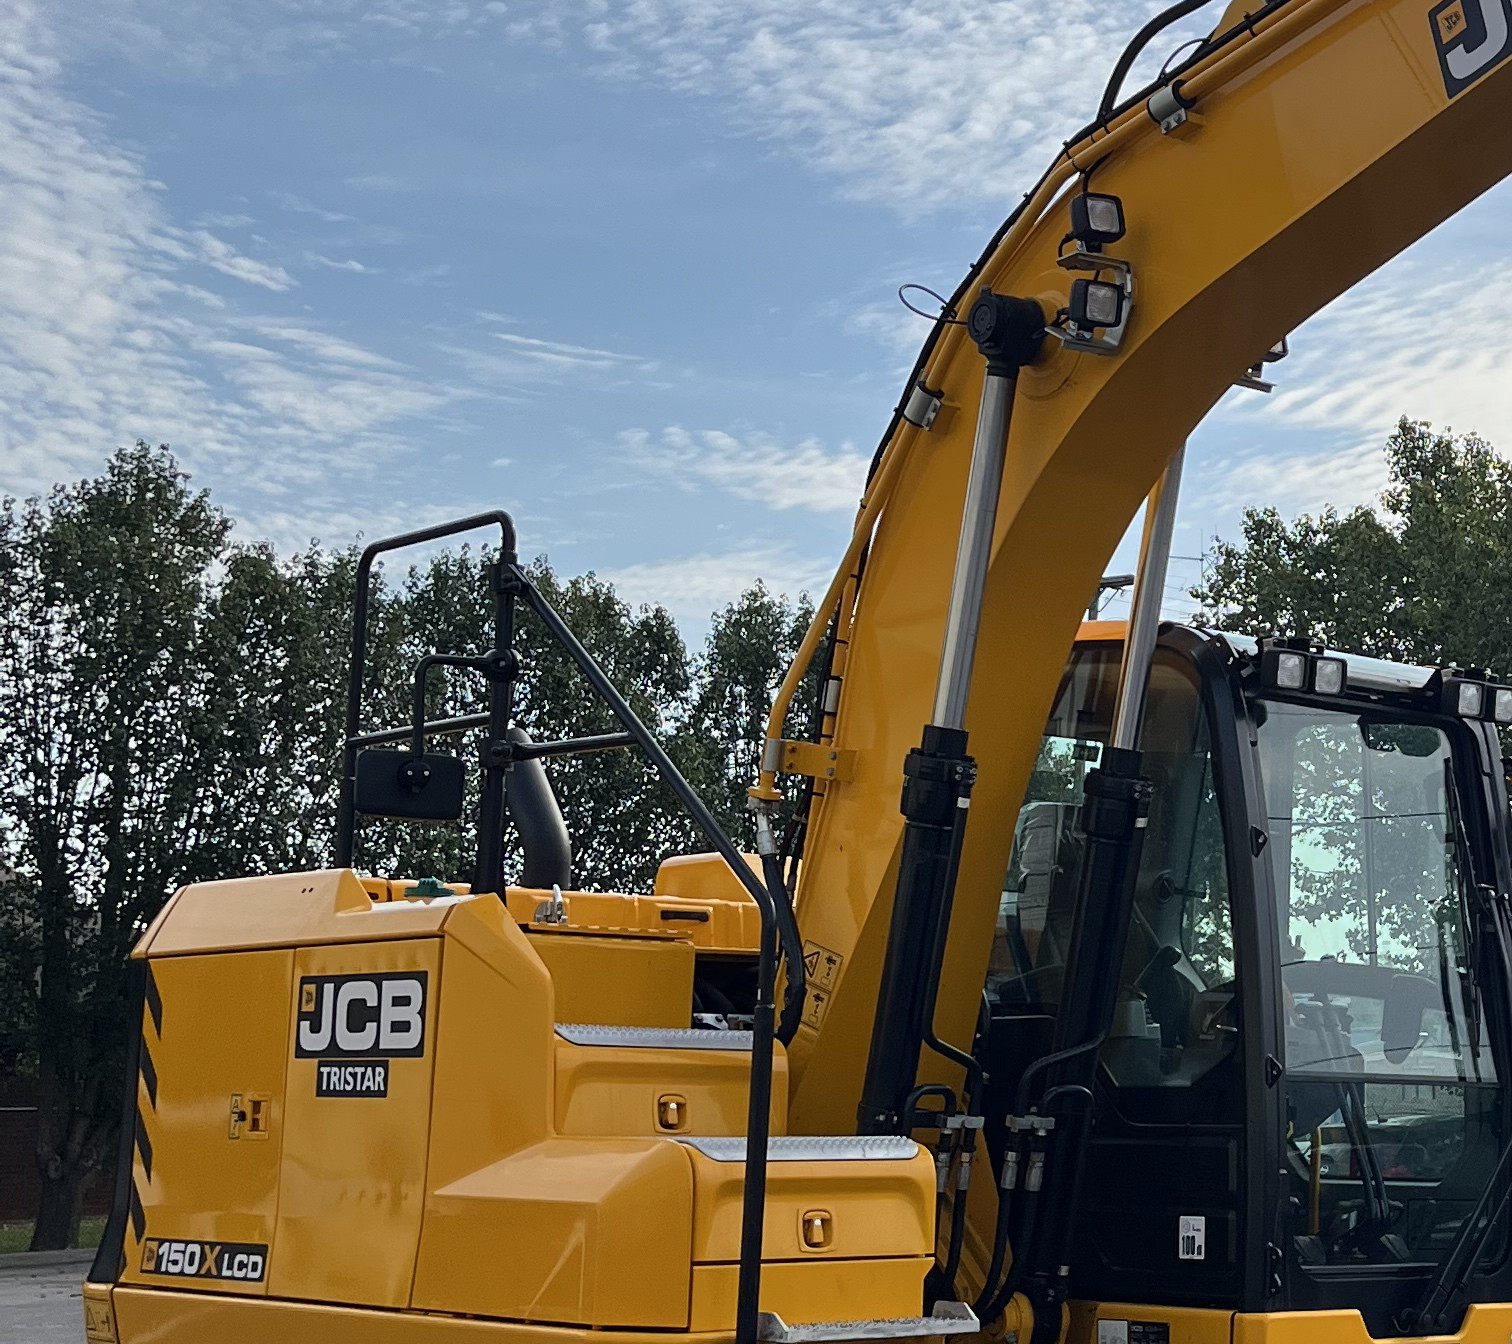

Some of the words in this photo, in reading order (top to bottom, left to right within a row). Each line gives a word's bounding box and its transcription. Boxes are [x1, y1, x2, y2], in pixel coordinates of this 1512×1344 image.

[299, 979, 423, 1051] JCB
[320, 1066, 385, 1091] TRISTAR
[221, 1253, 263, 1279] LCD
